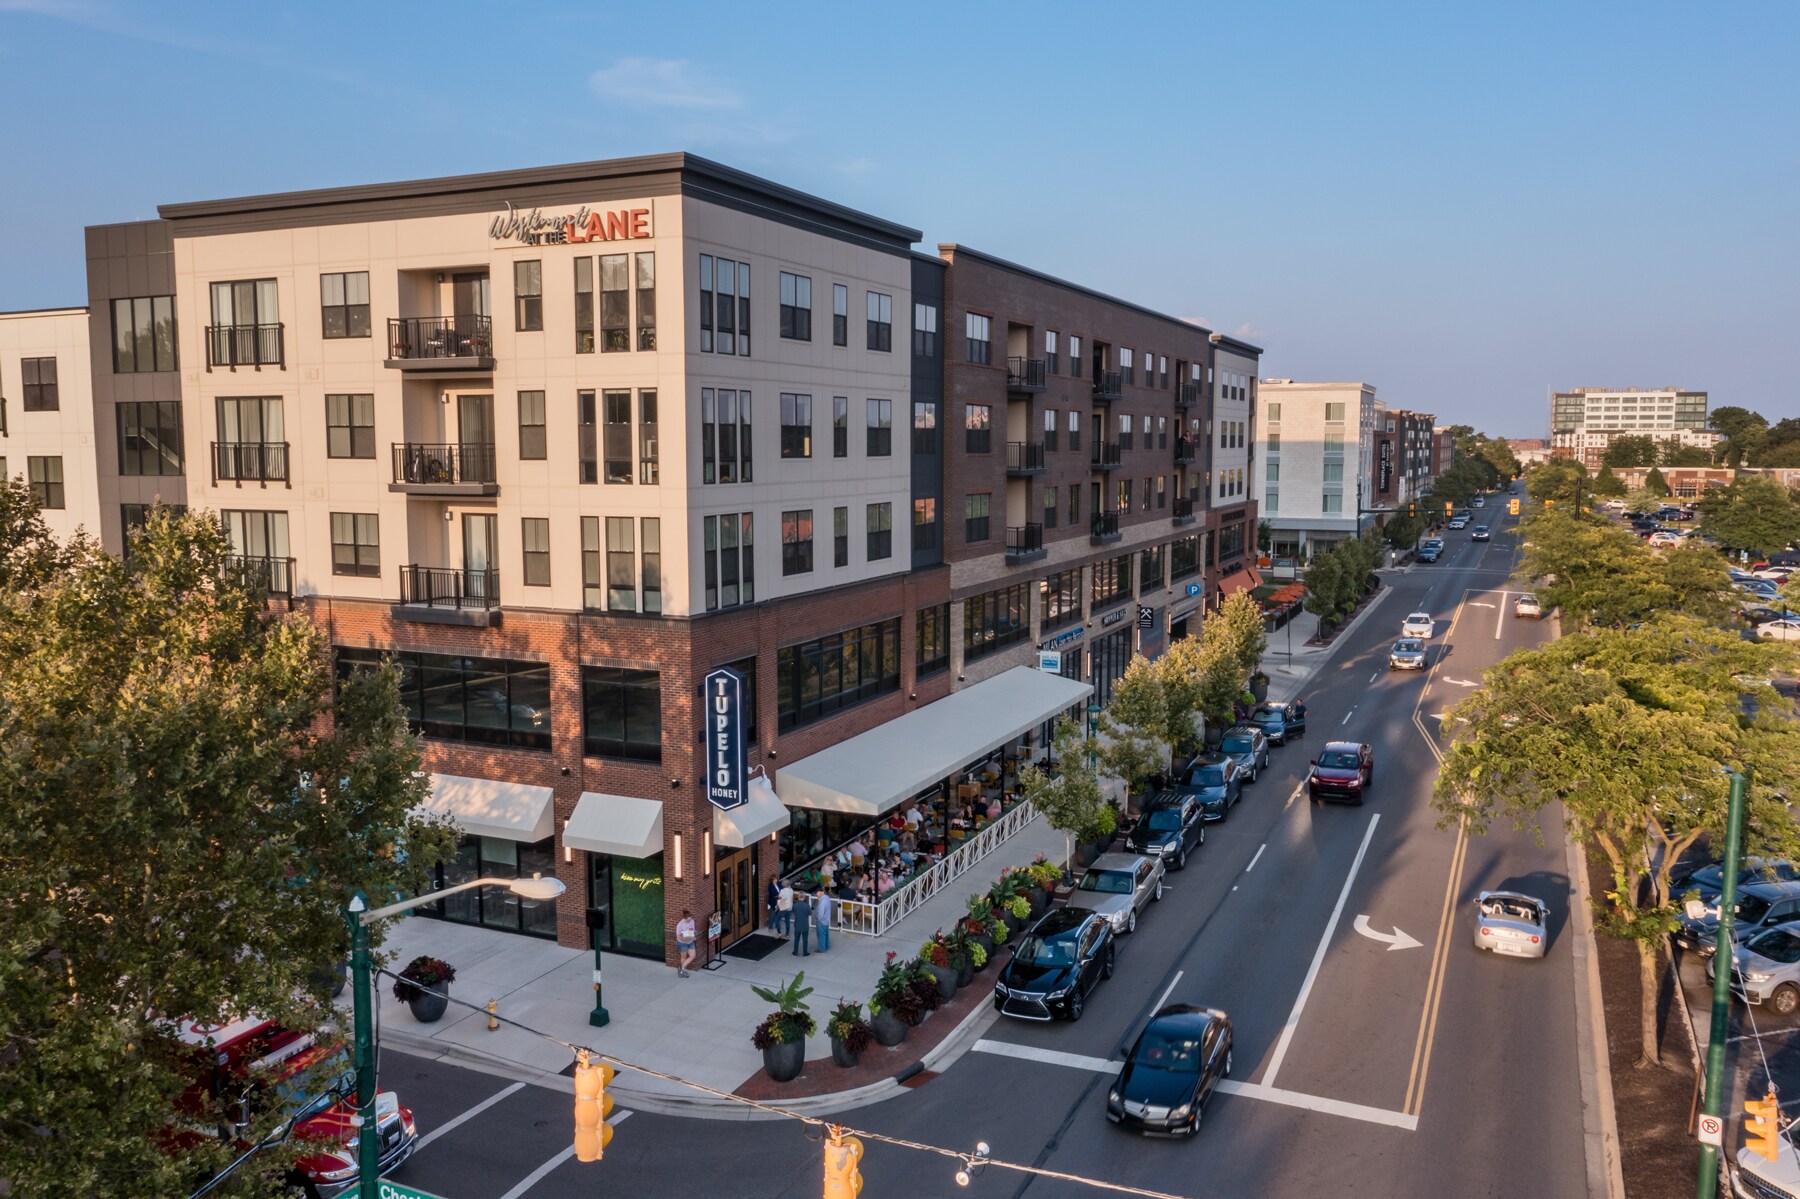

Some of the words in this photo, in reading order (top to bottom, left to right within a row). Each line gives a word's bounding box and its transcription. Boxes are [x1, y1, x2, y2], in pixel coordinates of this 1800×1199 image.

[527, 232, 541, 245] AT
[545, 230, 567, 244] THE
[567, 208, 650, 243] LANE
[715, 678, 730, 787] TUPELO
[711, 787, 738, 799] HONEY
